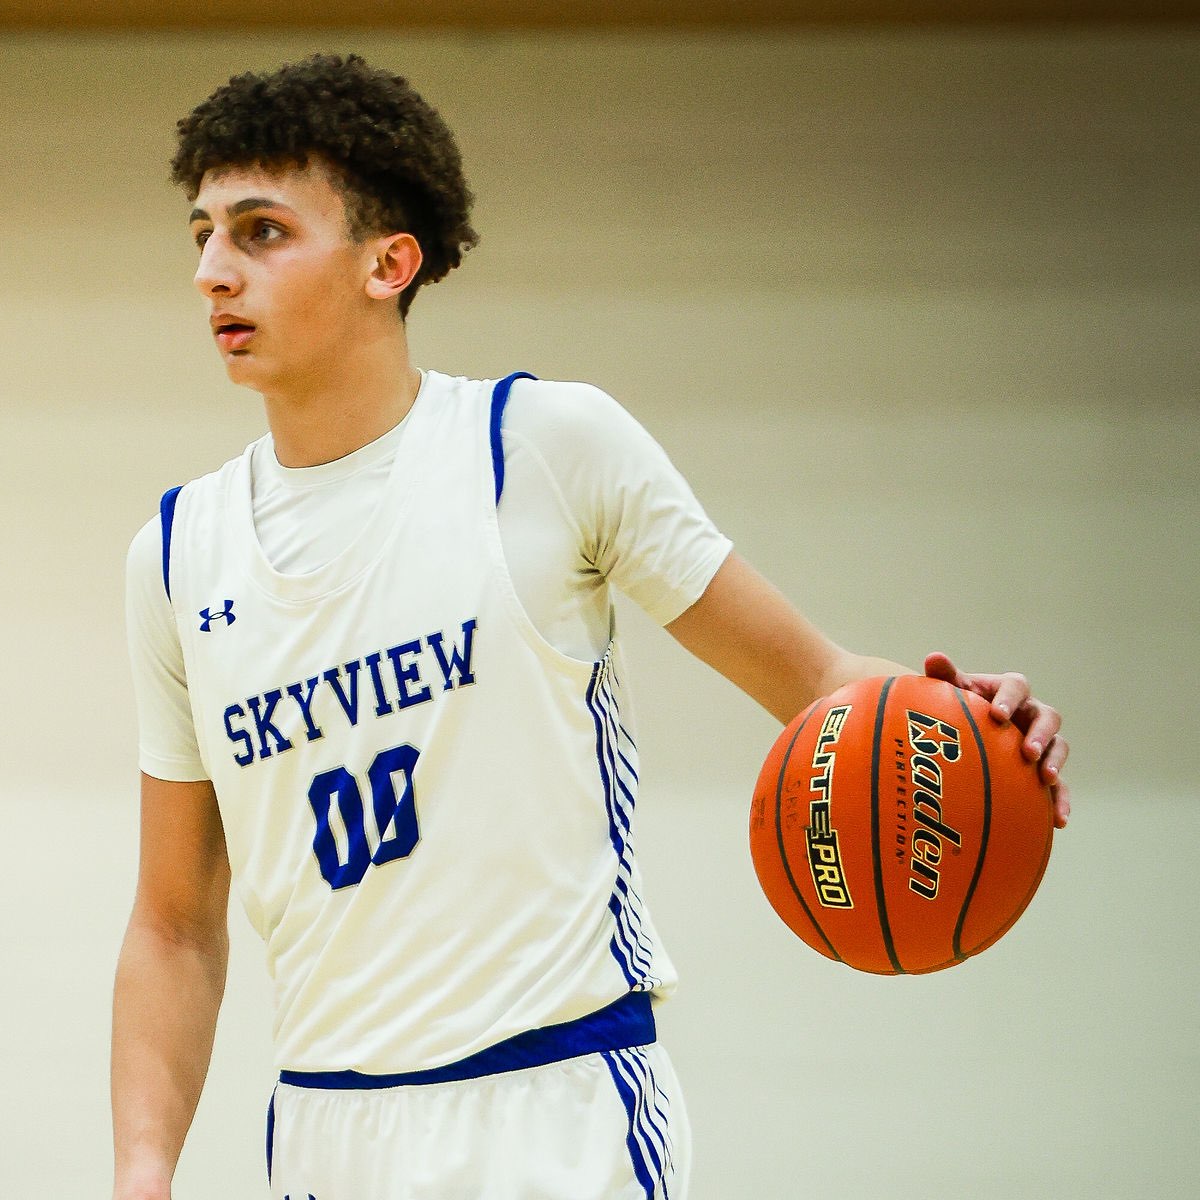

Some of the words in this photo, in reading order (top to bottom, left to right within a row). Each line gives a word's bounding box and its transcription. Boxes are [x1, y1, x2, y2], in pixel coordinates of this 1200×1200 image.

[223, 617, 477, 767] SKYVIEW
[306, 742, 422, 891] 00
[810, 839, 849, 904] PRO
[894, 738, 906, 863] PERFECTION
[905, 708, 962, 901] Baden
